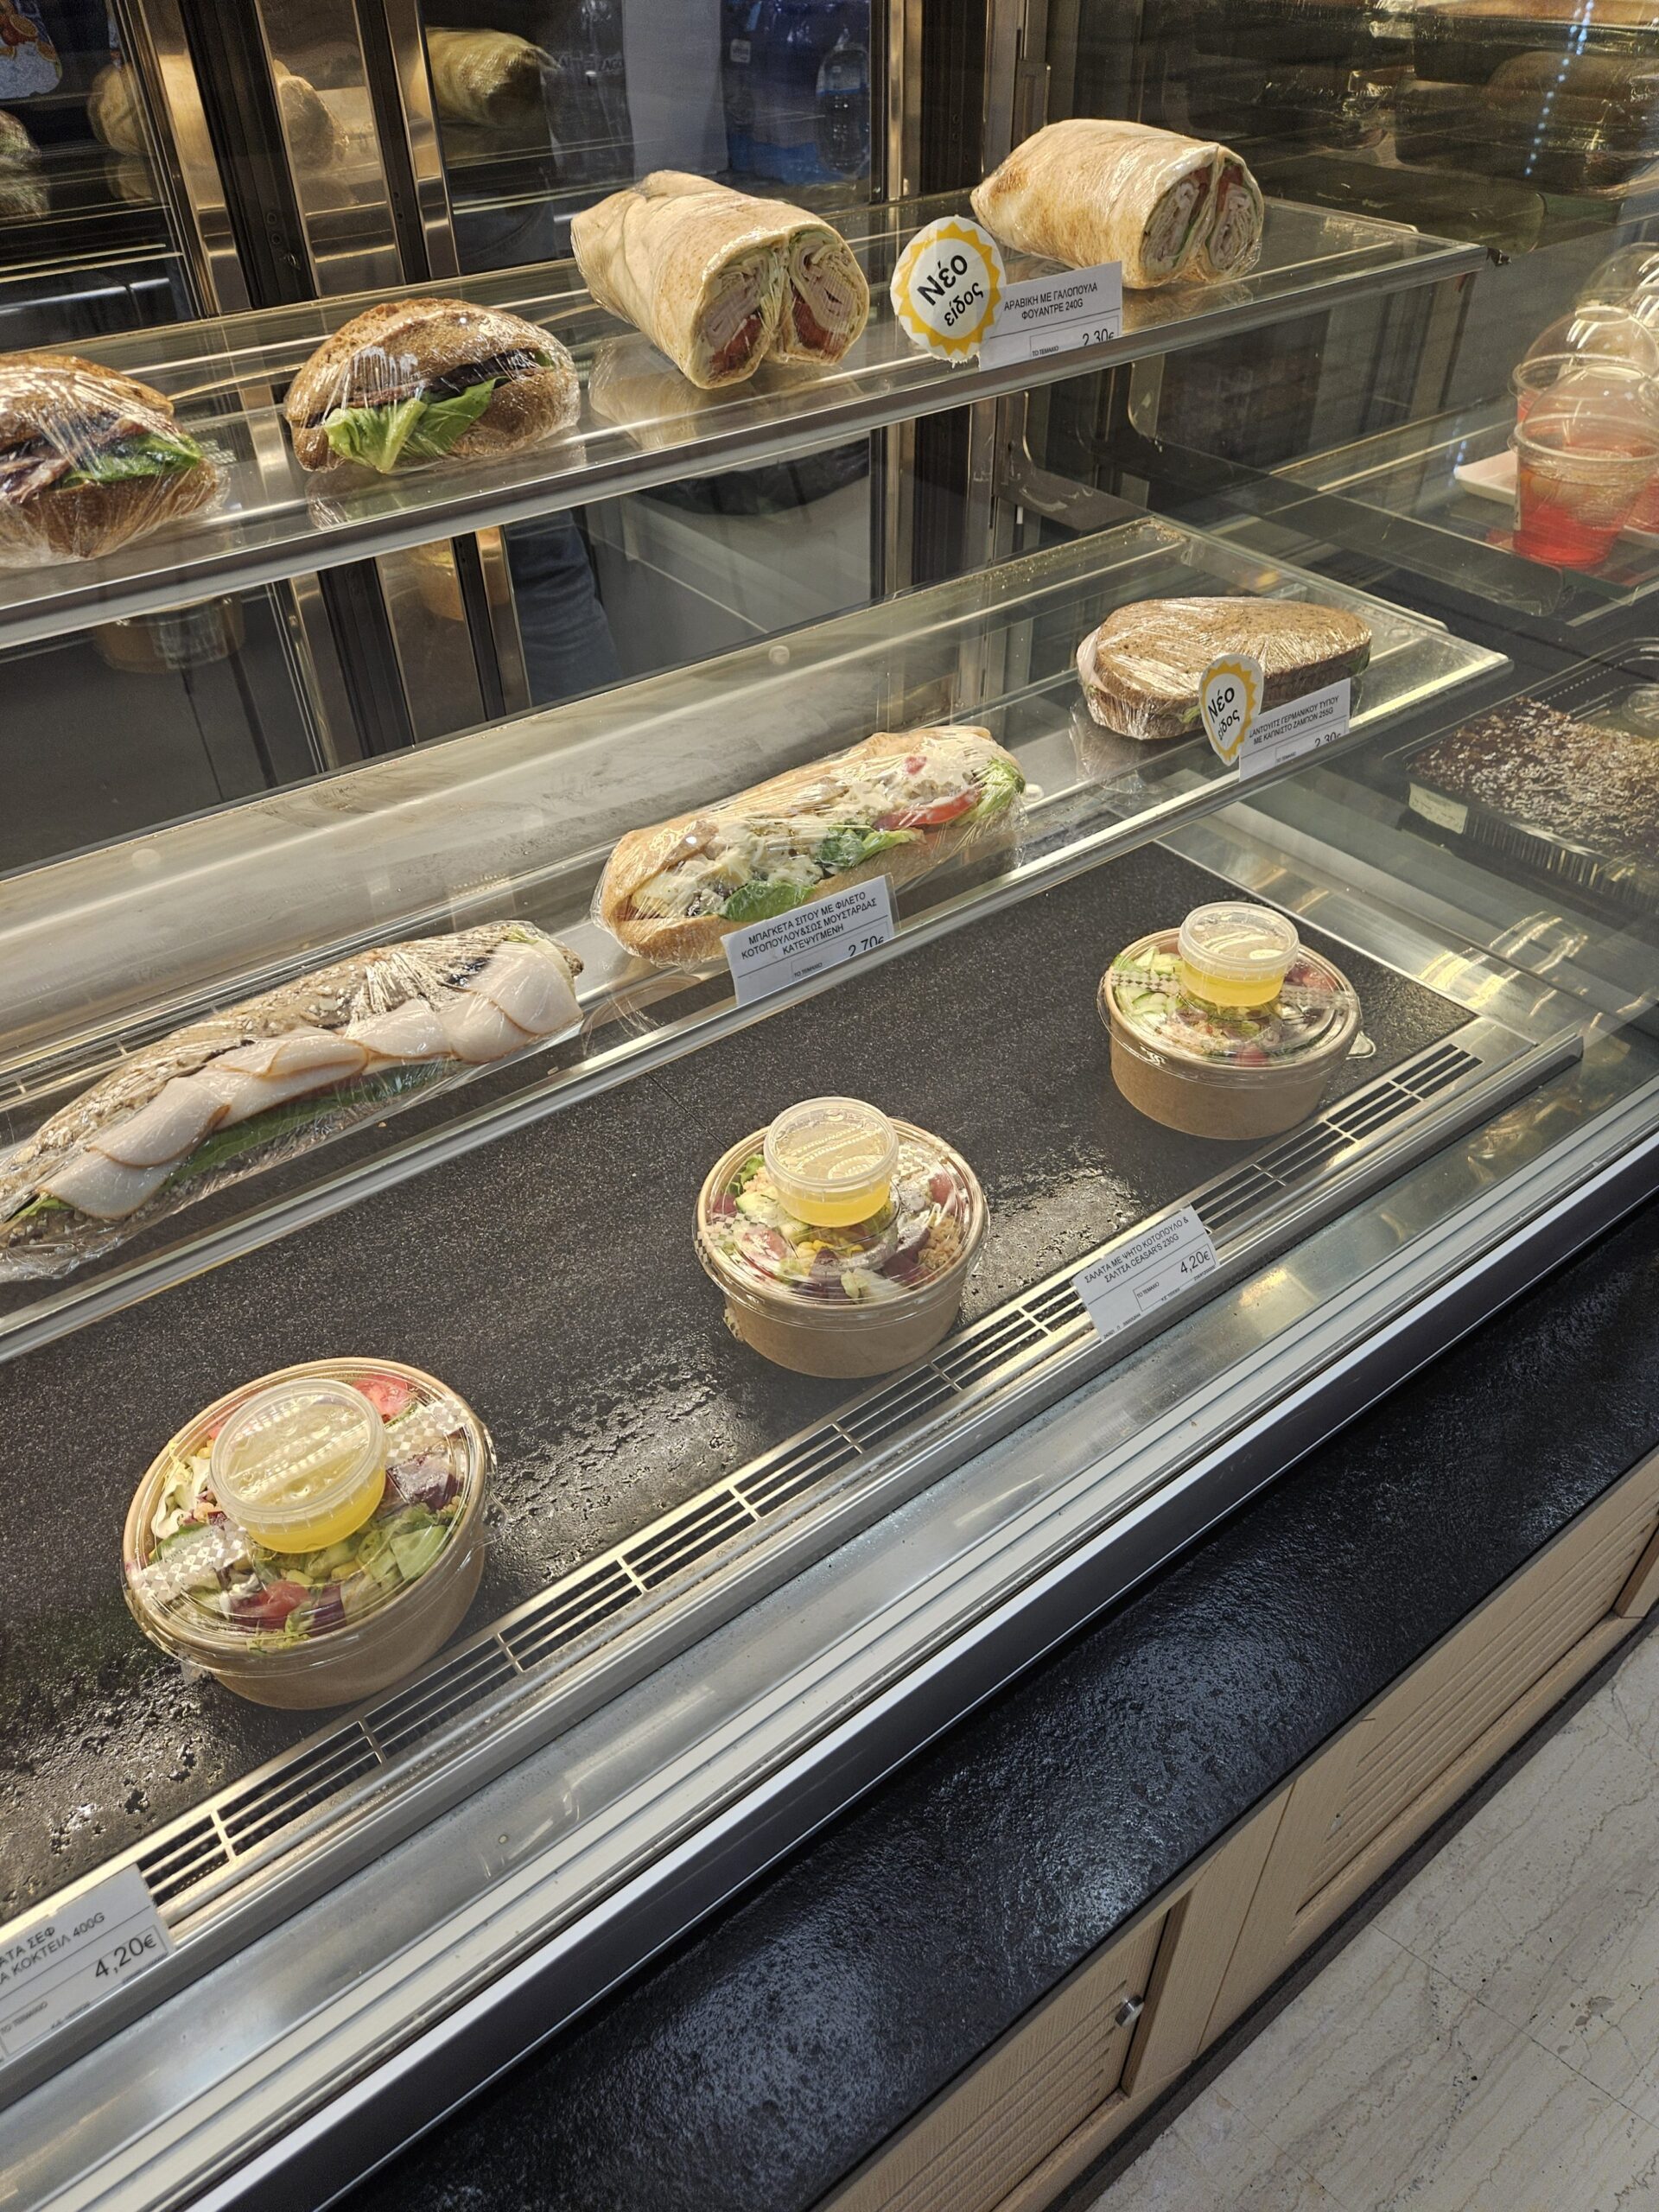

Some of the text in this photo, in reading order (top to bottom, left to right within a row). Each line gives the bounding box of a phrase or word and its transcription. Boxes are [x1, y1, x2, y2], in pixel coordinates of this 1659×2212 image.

[917, 255, 968, 306] Νέο
[1004, 282, 1097, 311] ΑΡΑΒΙΚΗ ΜΕ ΓΑΛΟΠΟΥΛΑ
[944, 282, 983, 327] είδος
[1021, 298, 1084, 321] ΦΟΥΑΝΤΡΕ 240G
[1208, 687, 1235, 723] Νέο
[1319, 696, 1339, 709] ΤΥΠΟΥ
[1254, 735, 1263, 745] ΜΕ
[741, 899, 877, 960] ΚΟΤΟΠΟΥΛΟΥ&ΣΩΣ ΜΟΥΣΤΑΡΔΑΣ
[748, 891, 866, 945] ΜΠΑΓΚΕΤΑ ΣΙΤΟΥ ΜΕ ΦΙΛΕΤΟ
[782, 924, 844, 955] ΚΑΤΕΨΥΓΜΕΝΗ
[1084, 1216, 1189, 1283] ΣΑΛΑΤΑ ΜΕ ΨΗΤΟ ΚΟΤΟΠΟΥΛΟ &
[1104, 1233, 1179, 1283] ΣΑΛΤΣΑ CEASAR'S 230G
[1180, 1250, 1211, 1274] 4,20€
[11, 1934, 71, 1976] ΚΟΚΤΕΙΛ
[73, 1912, 105, 1937] 400G
[27, 1927, 55, 1949] ΣΕΦ
[95, 1934, 157, 1978] 4,20€
